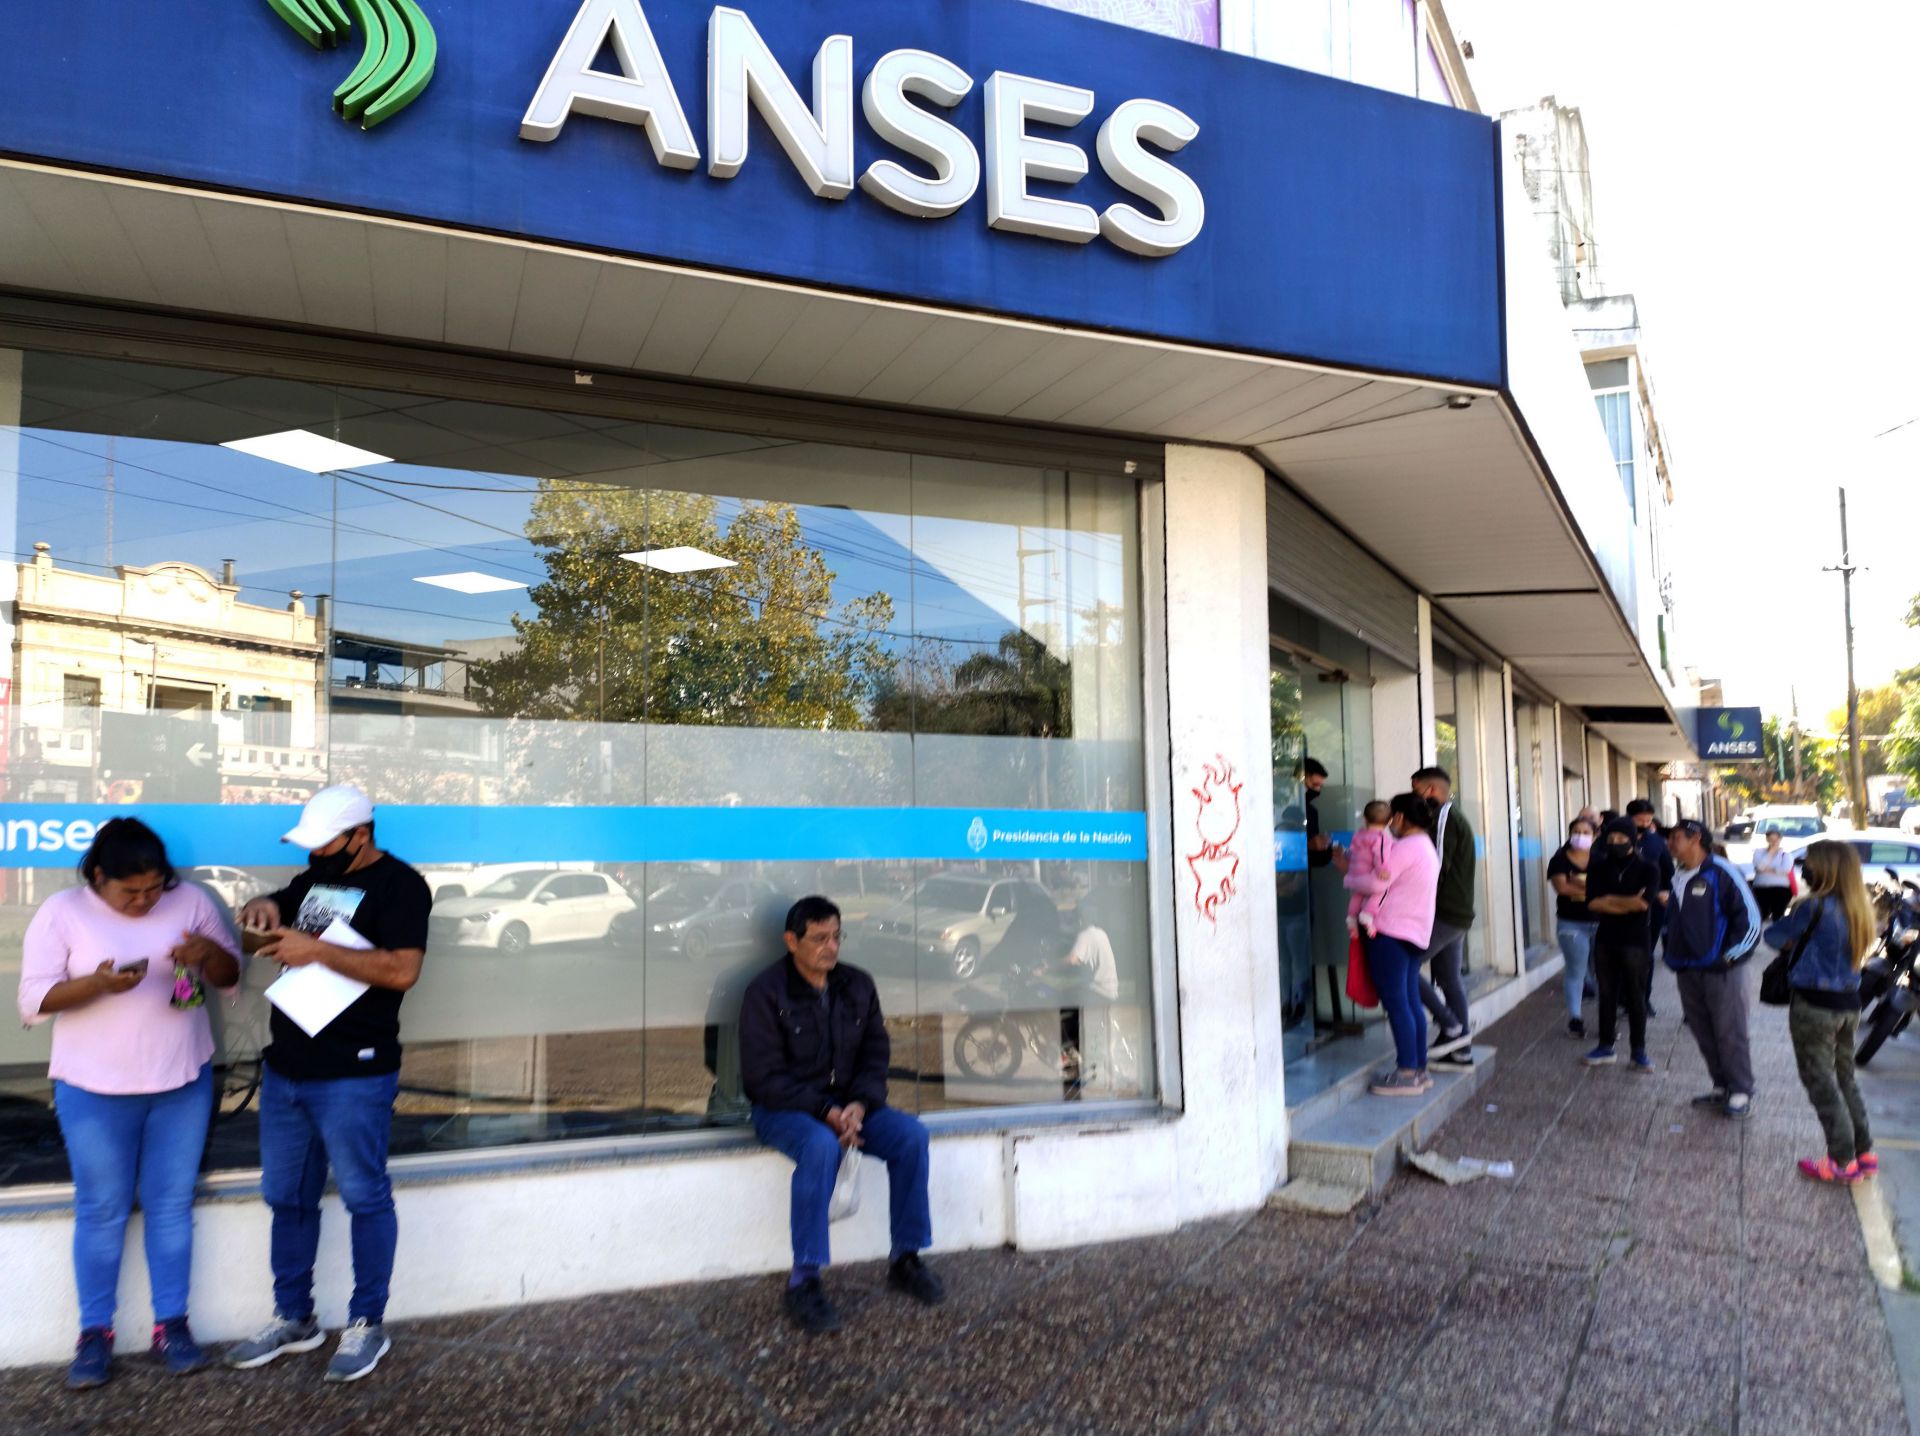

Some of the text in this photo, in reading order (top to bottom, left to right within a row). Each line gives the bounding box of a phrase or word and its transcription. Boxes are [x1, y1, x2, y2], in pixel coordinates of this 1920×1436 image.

[519, 0, 1205, 258] ANSES
[1707, 740, 1758, 755] ANSES
[0, 818, 110, 852] nse
[993, 829, 1132, 845] Presidencia de la Nación
